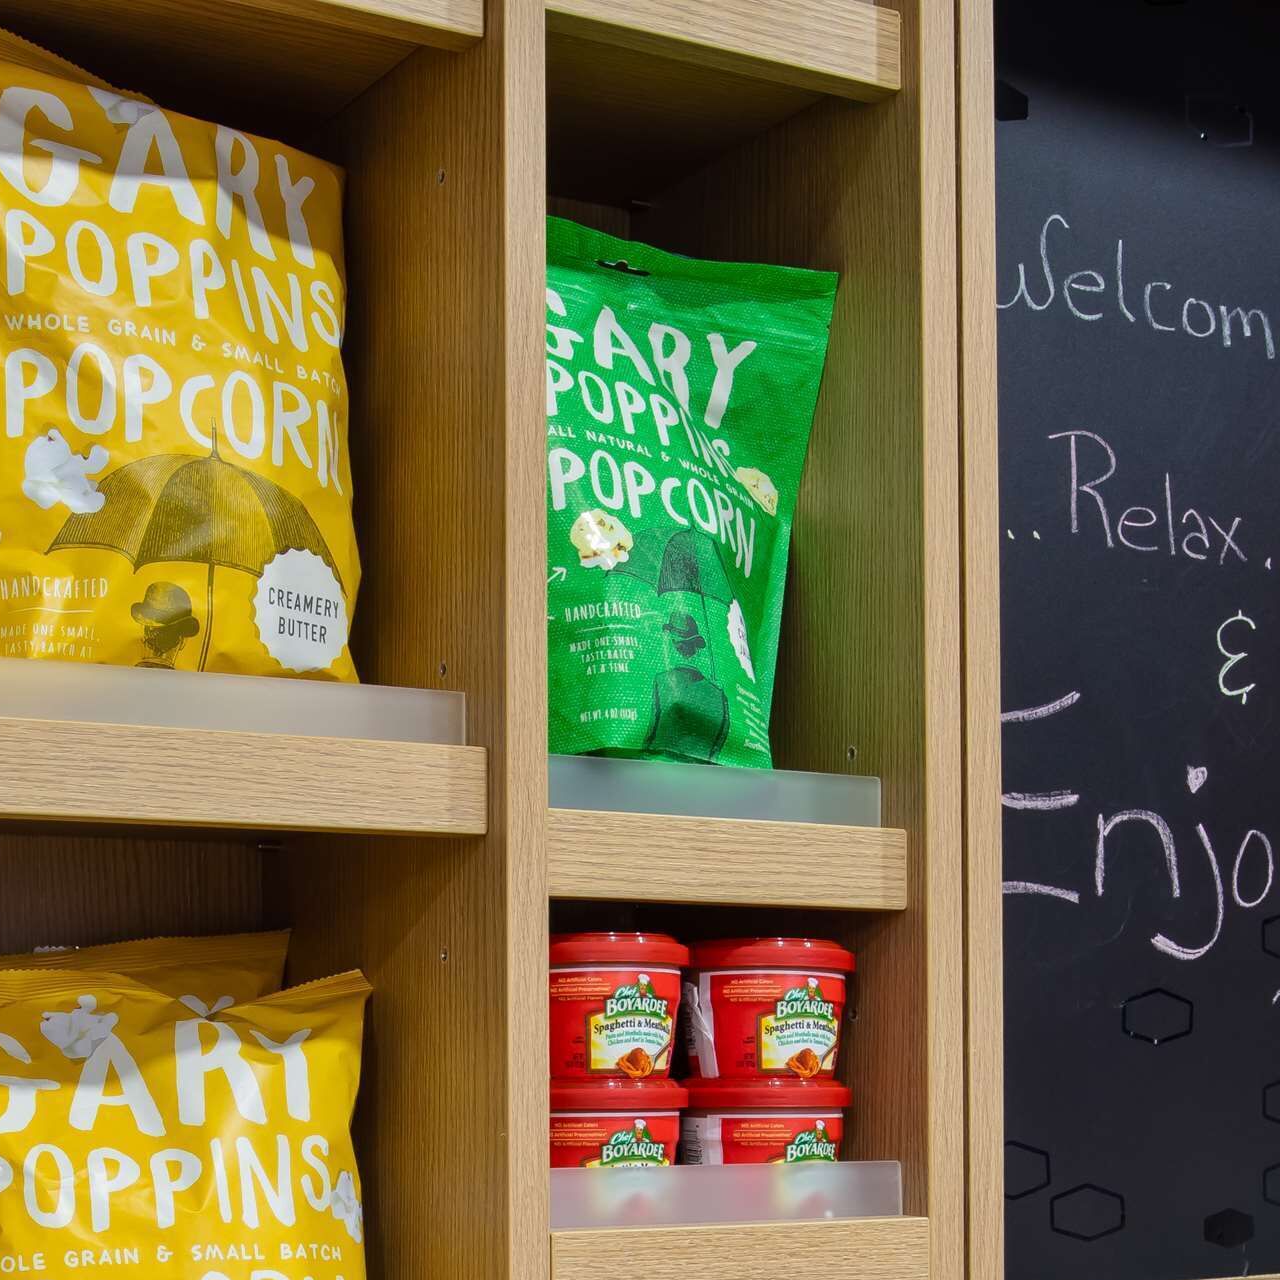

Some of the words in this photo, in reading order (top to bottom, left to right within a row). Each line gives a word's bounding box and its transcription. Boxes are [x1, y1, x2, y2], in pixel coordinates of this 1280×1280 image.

[5, 209, 342, 353] POPPINS
[4, 313, 90, 333] WHOLE
[108, 319, 176, 346] GRAIN
[191, 334, 206, 352] &
[221, 342, 284, 375] SMALL
[297, 364, 341, 397] BATCH
[5, 342, 343, 497] POPCORN
[586, 430, 652, 458] NATURAL
[548, 447, 755, 578] POPCORN
[0, 575, 108, 600] HANDCRAFTED
[268, 586, 340, 618] CREAMERY
[564, 600, 641, 622] HANDCRAFTED
[278, 616, 328, 645] BUTTER
[1216, 610, 1256, 704] &
[607, 998, 668, 1017] BOYARDEE
[776, 1000, 833, 1018] BOYARDEE
[594, 1018, 636, 1034] Spaghetti
[764, 1019, 804, 1034] Spaghetti
[601, 1142, 664, 1161] BOYARDEE
[786, 1142, 836, 1161] BOYARDEE
[64, 1249, 139, 1268] GRAIN
[156, 1248, 172, 1264] &
[191, 1244, 265, 1261] SMALL
[280, 1243, 342, 1262] BATCH
